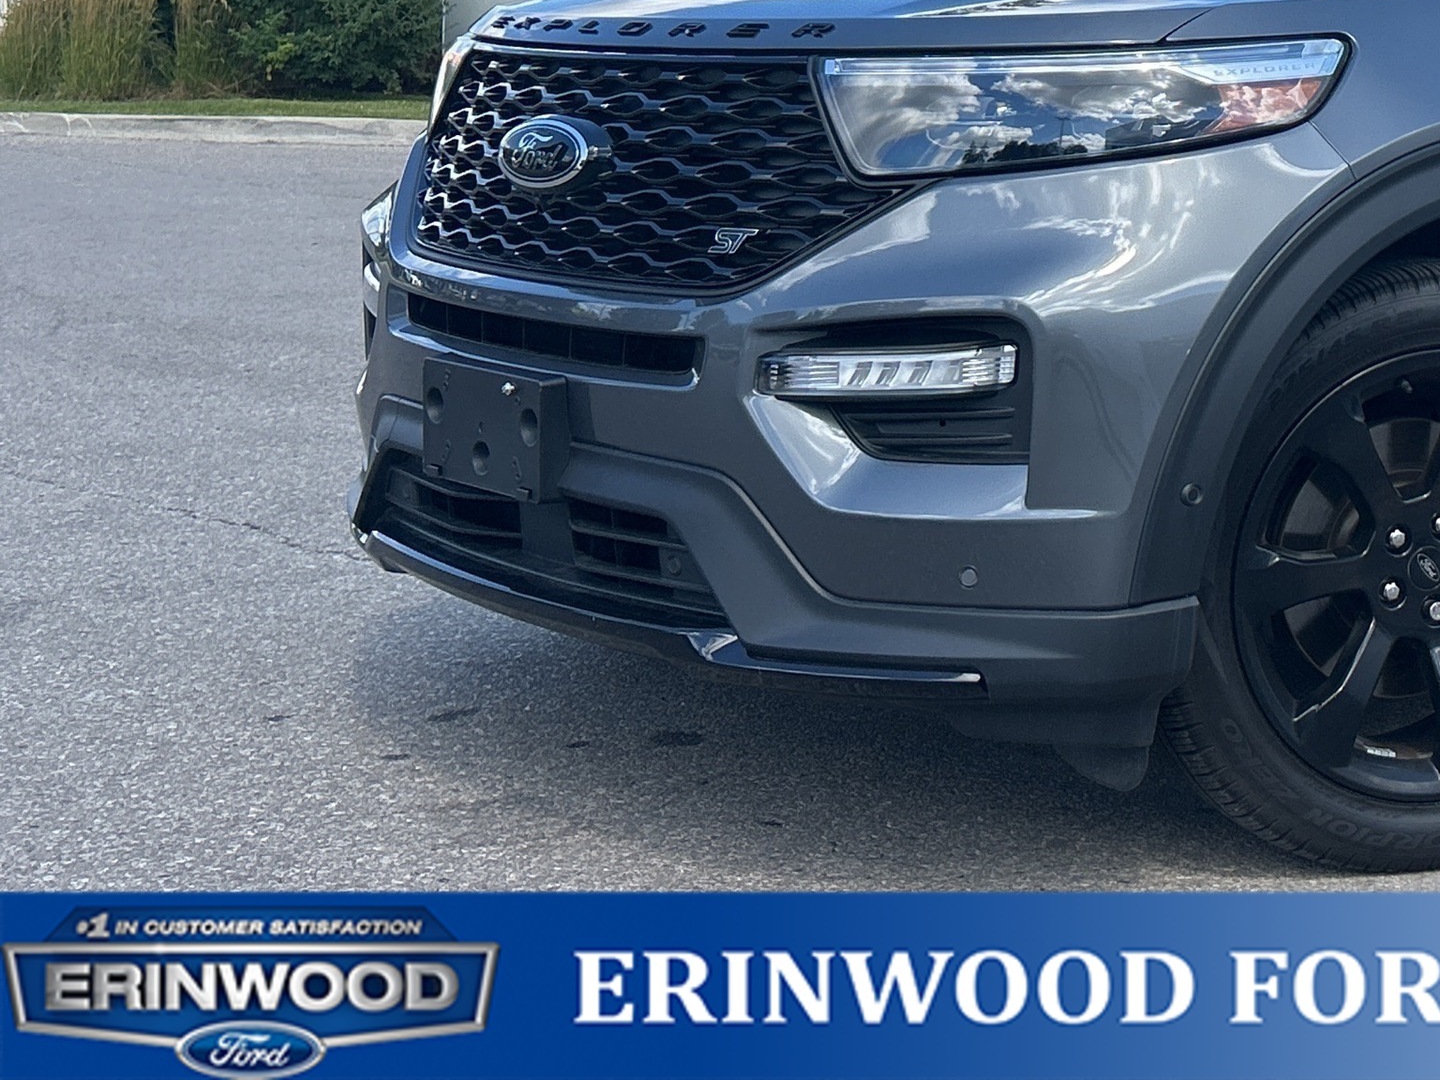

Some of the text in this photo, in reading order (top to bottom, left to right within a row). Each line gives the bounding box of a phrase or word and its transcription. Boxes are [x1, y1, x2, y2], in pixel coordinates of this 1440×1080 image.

[492, 16, 837, 39] EXPLORER
[1213, 62, 1316, 77] EXPLORER
[511, 131, 564, 171] Ford
[707, 227, 760, 254] ST
